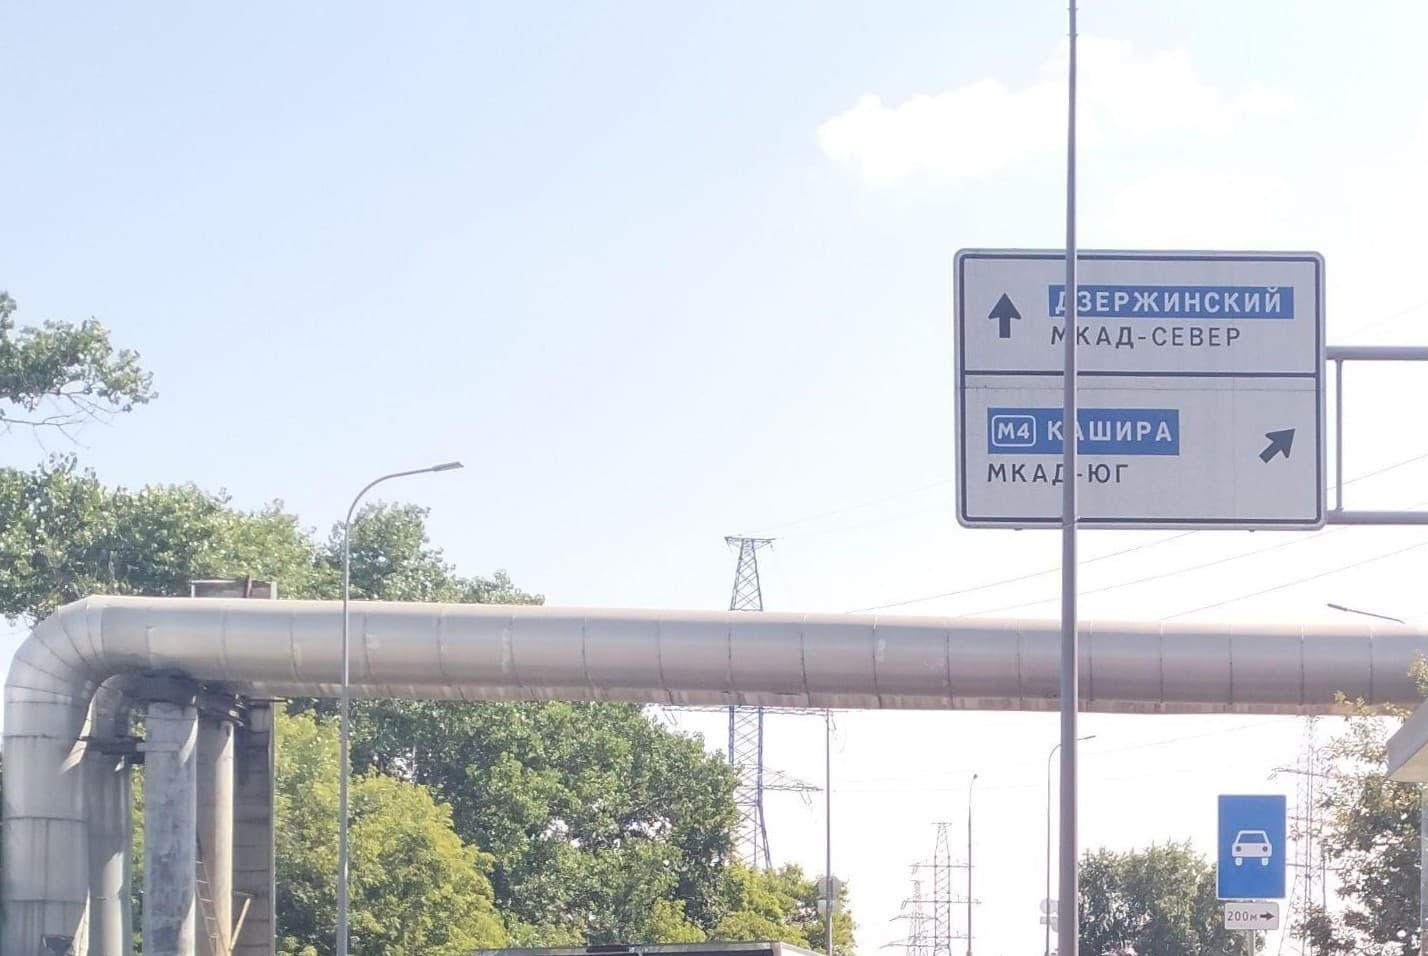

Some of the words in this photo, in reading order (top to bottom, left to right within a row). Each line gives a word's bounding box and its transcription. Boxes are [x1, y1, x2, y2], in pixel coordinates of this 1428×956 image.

[1051, 325, 1240, 349] МКАД-СЕВЕР
[997, 422, 1030, 440] М4
[988, 463, 1129, 486] МКАД-ЮГ
